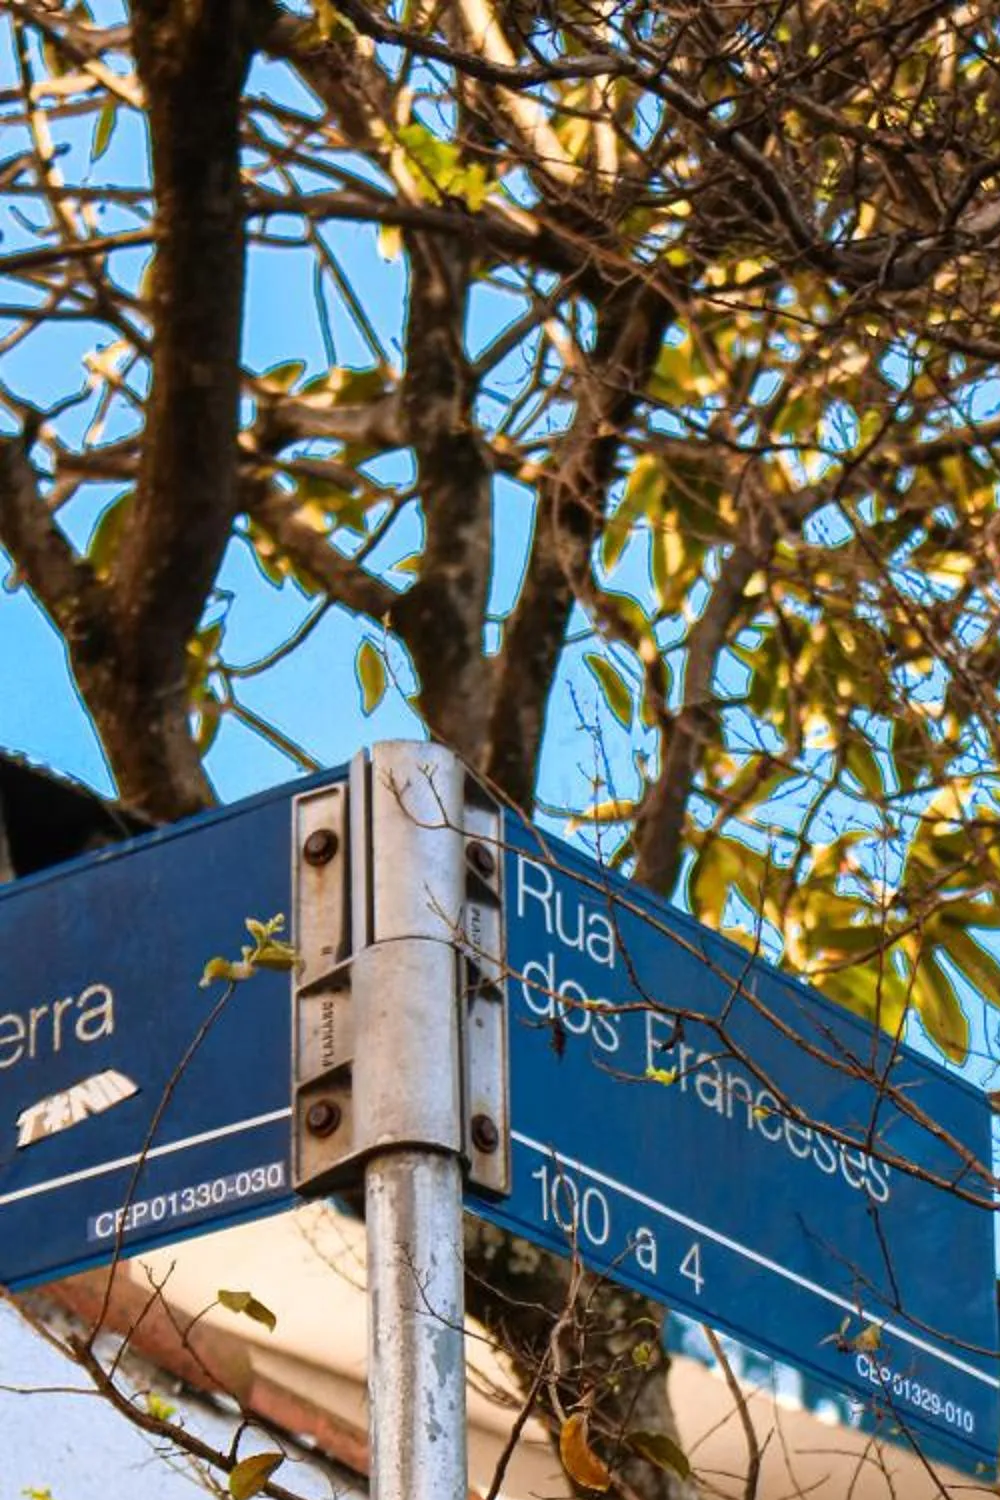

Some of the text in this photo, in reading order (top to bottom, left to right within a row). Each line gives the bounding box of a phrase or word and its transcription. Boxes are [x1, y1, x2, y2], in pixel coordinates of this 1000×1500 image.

[517, 854, 617, 969] Rua
[521, 953, 890, 1203] dos Franceses
[531, 1164, 705, 1296] 100 a 4
